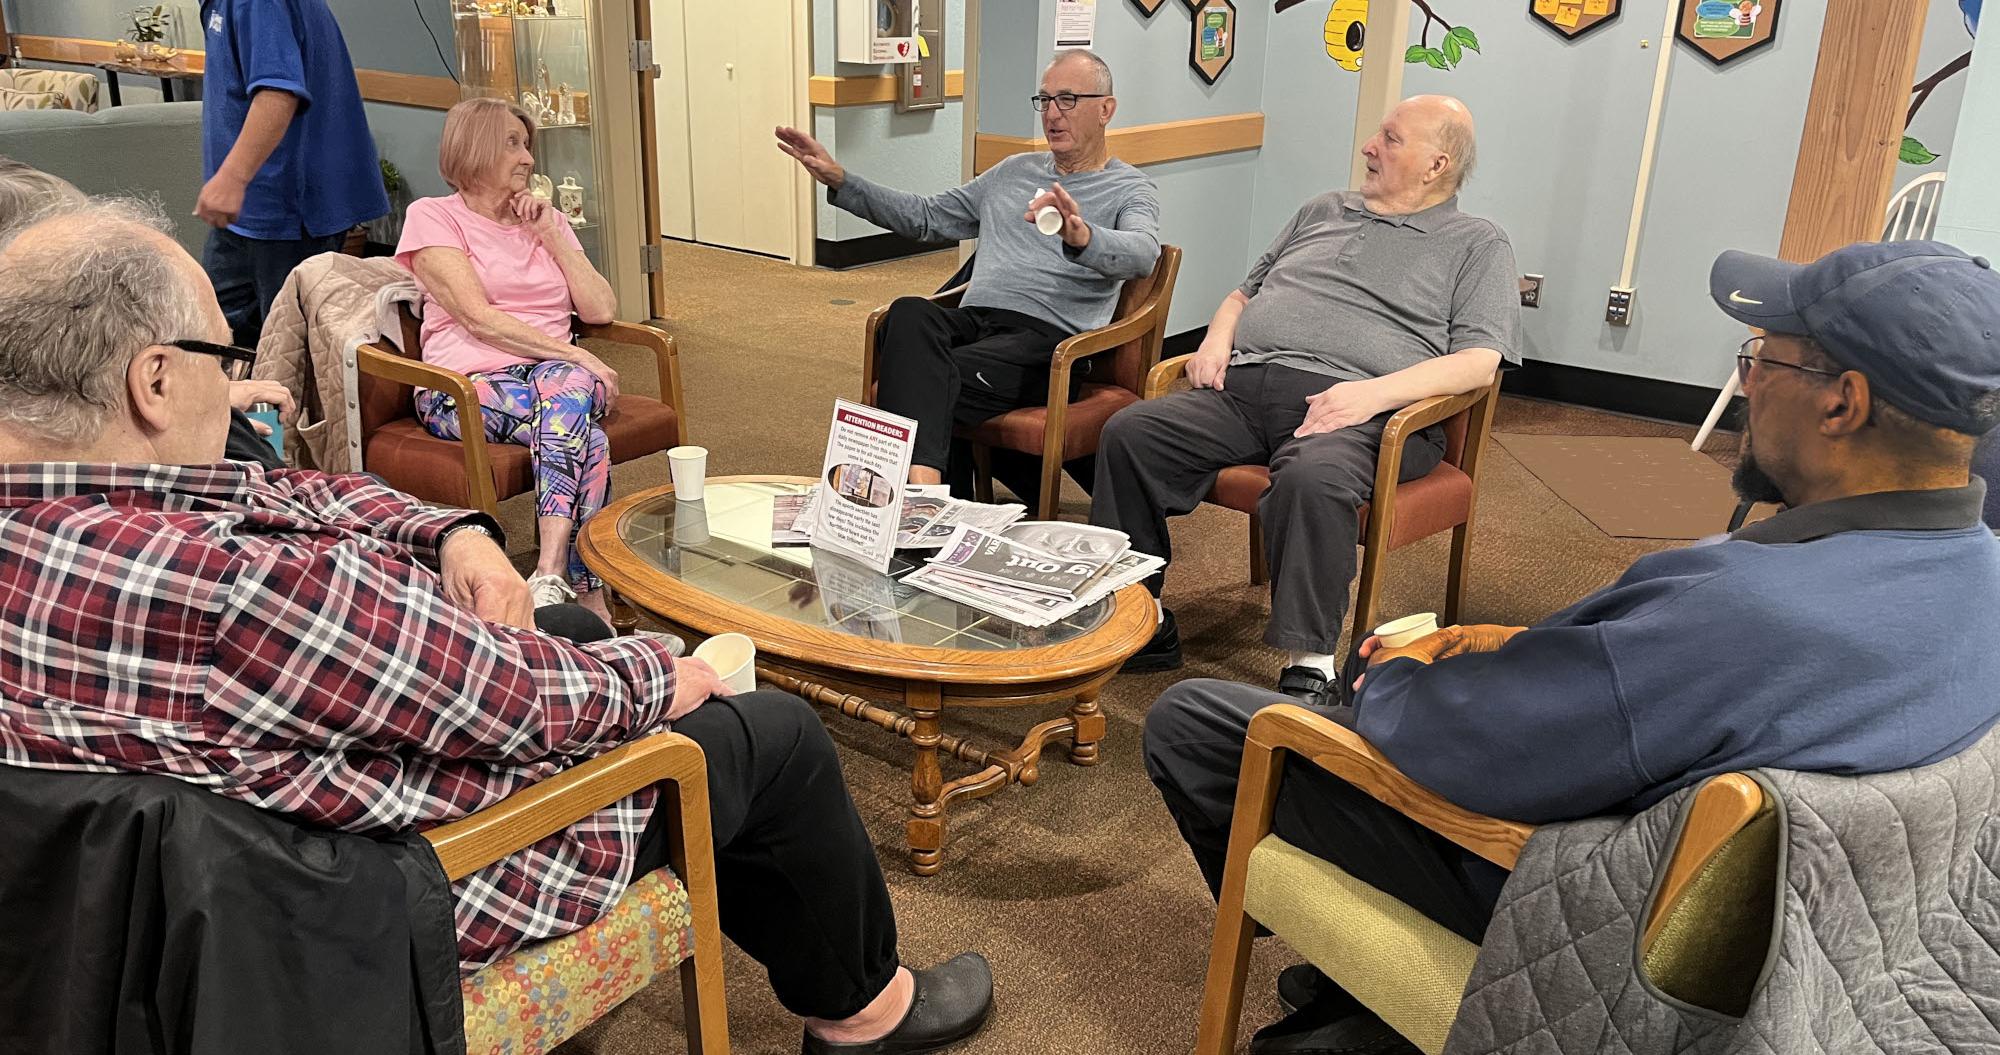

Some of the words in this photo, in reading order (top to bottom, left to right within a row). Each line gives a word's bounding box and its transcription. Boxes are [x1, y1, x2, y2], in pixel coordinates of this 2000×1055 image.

[844, 414, 876, 430] ATTENTION
[877, 425, 903, 438] READERS
[1006, 555, 1061, 573] Out
